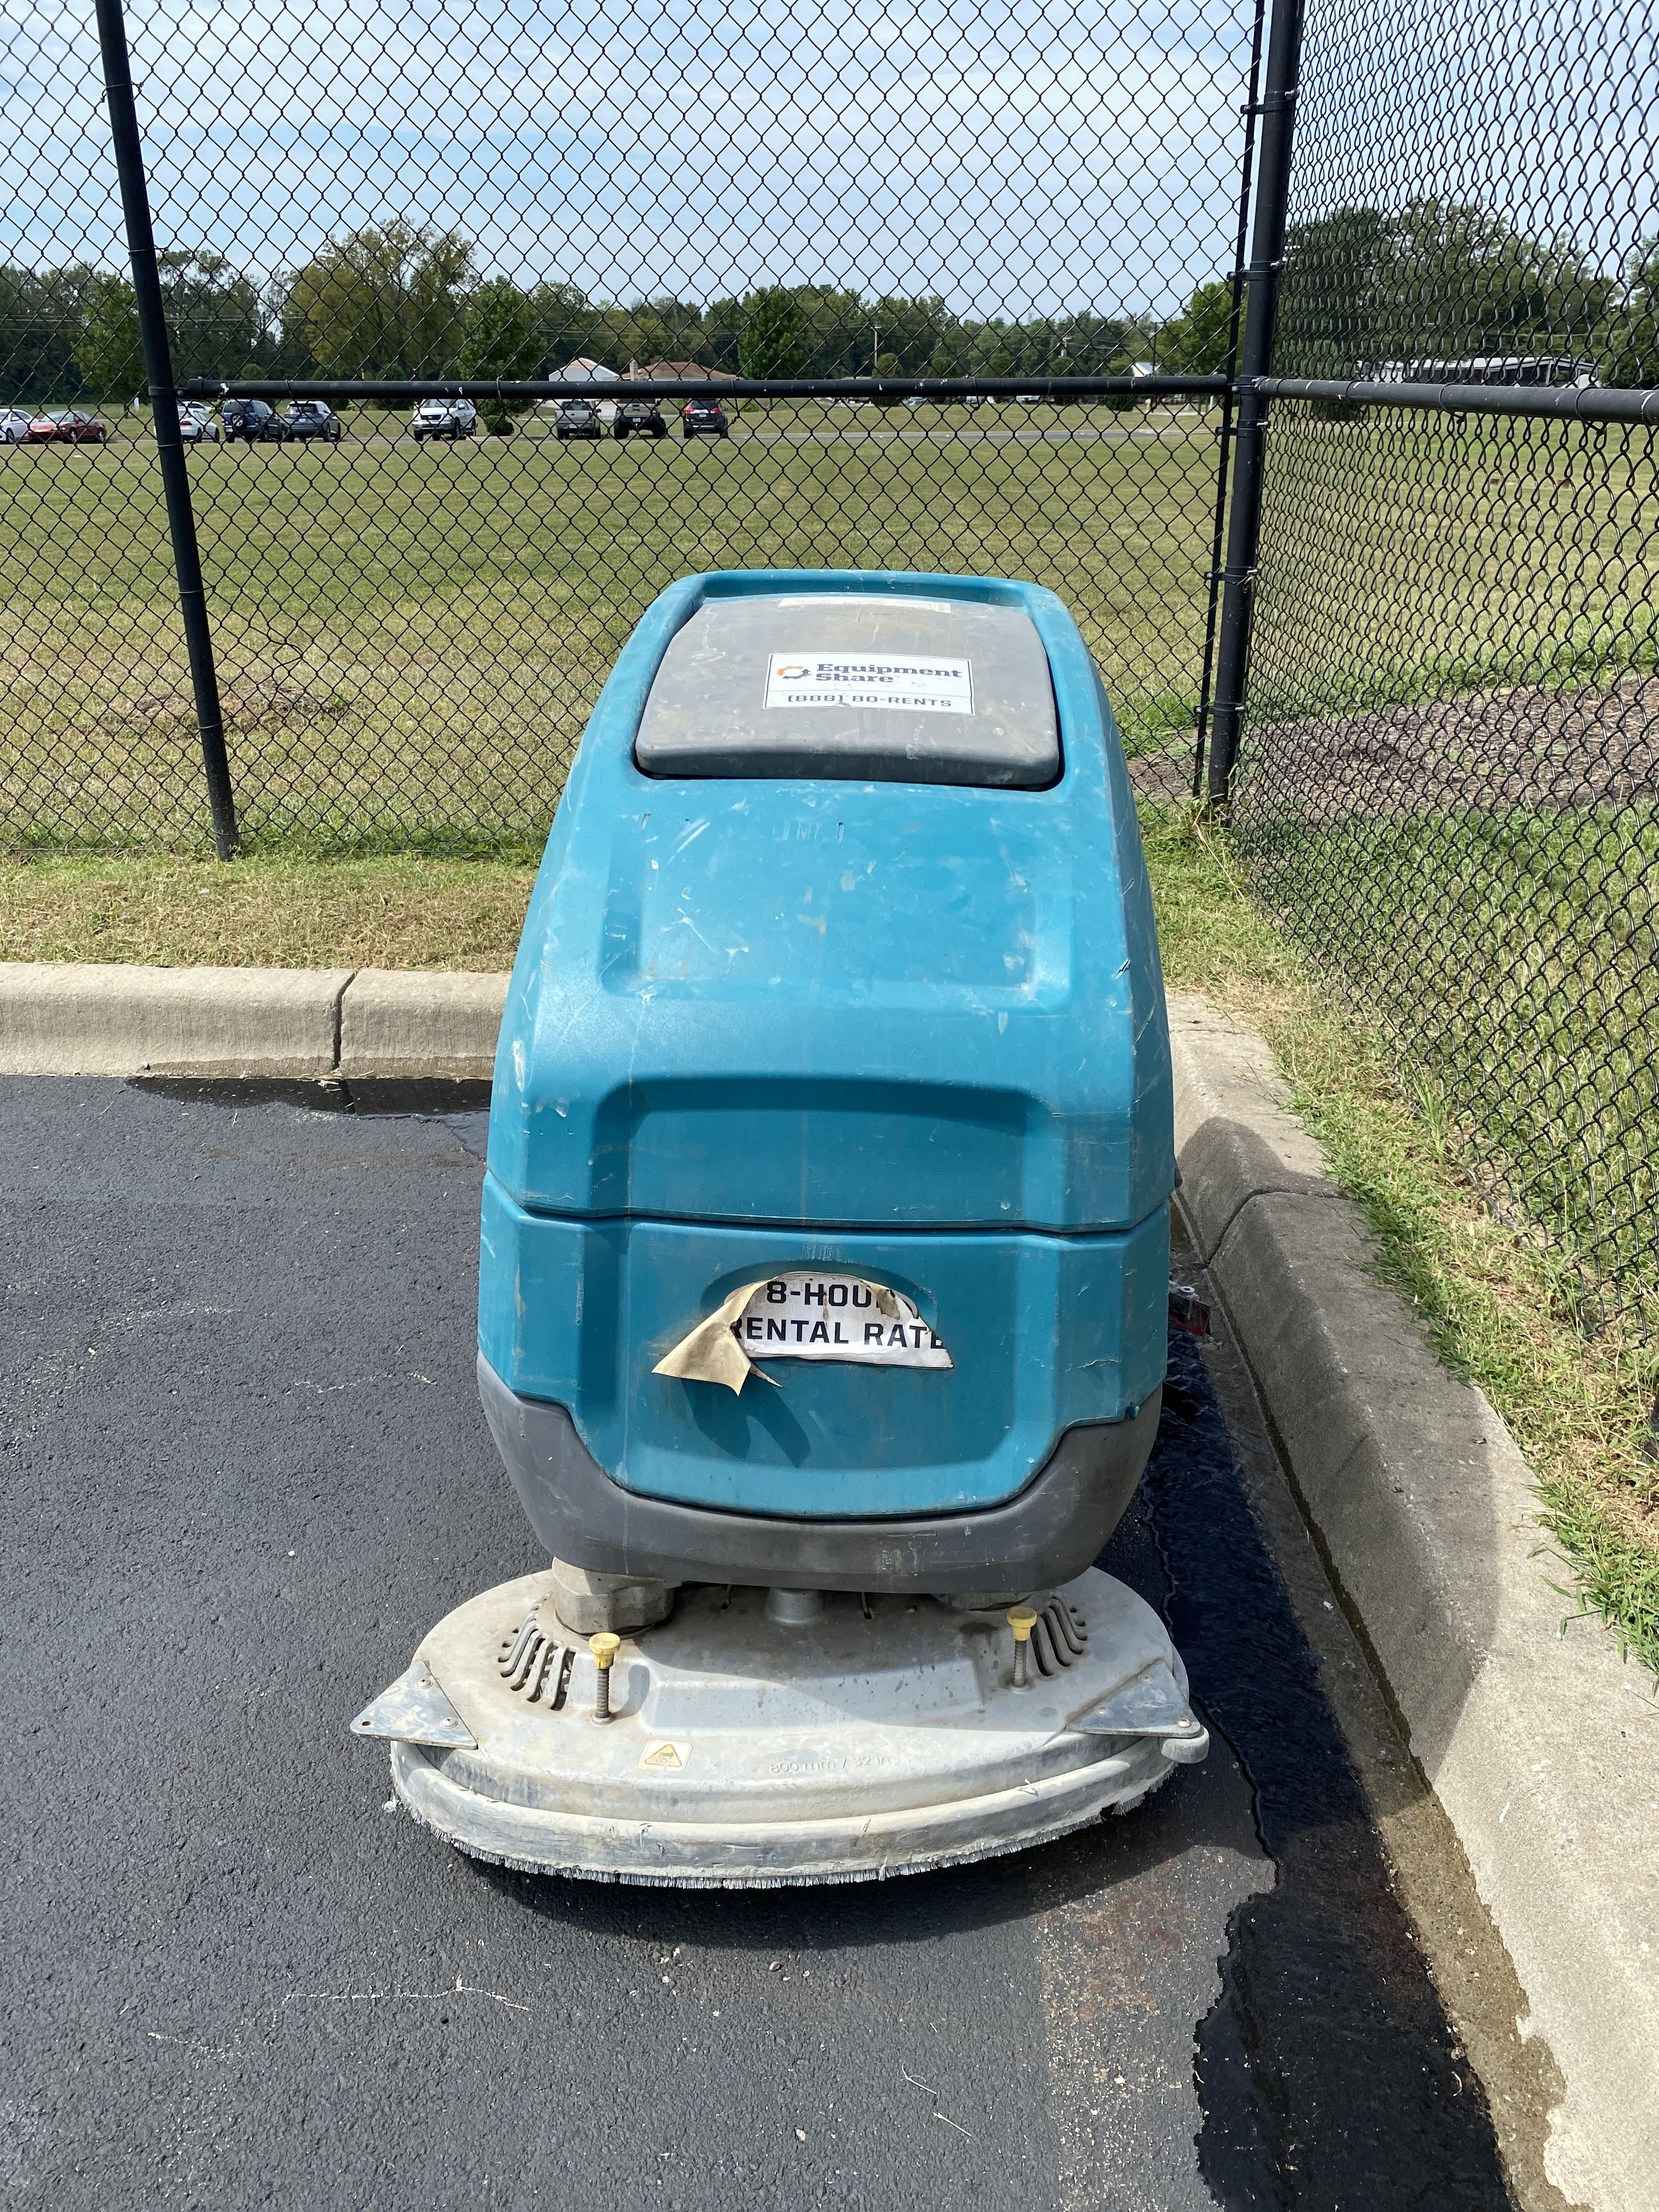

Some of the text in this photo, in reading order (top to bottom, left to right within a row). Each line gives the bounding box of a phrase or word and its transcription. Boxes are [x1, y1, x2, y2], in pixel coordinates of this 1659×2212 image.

[816, 663, 962, 678] Equipment
[816, 673, 894, 682] Share
[852, 696, 951, 707] 80-RENTS
[767, 1281, 895, 1308] 8-HOU
[771, 1763, 799, 1773] 800
[805, 1761, 836, 1770] mm
